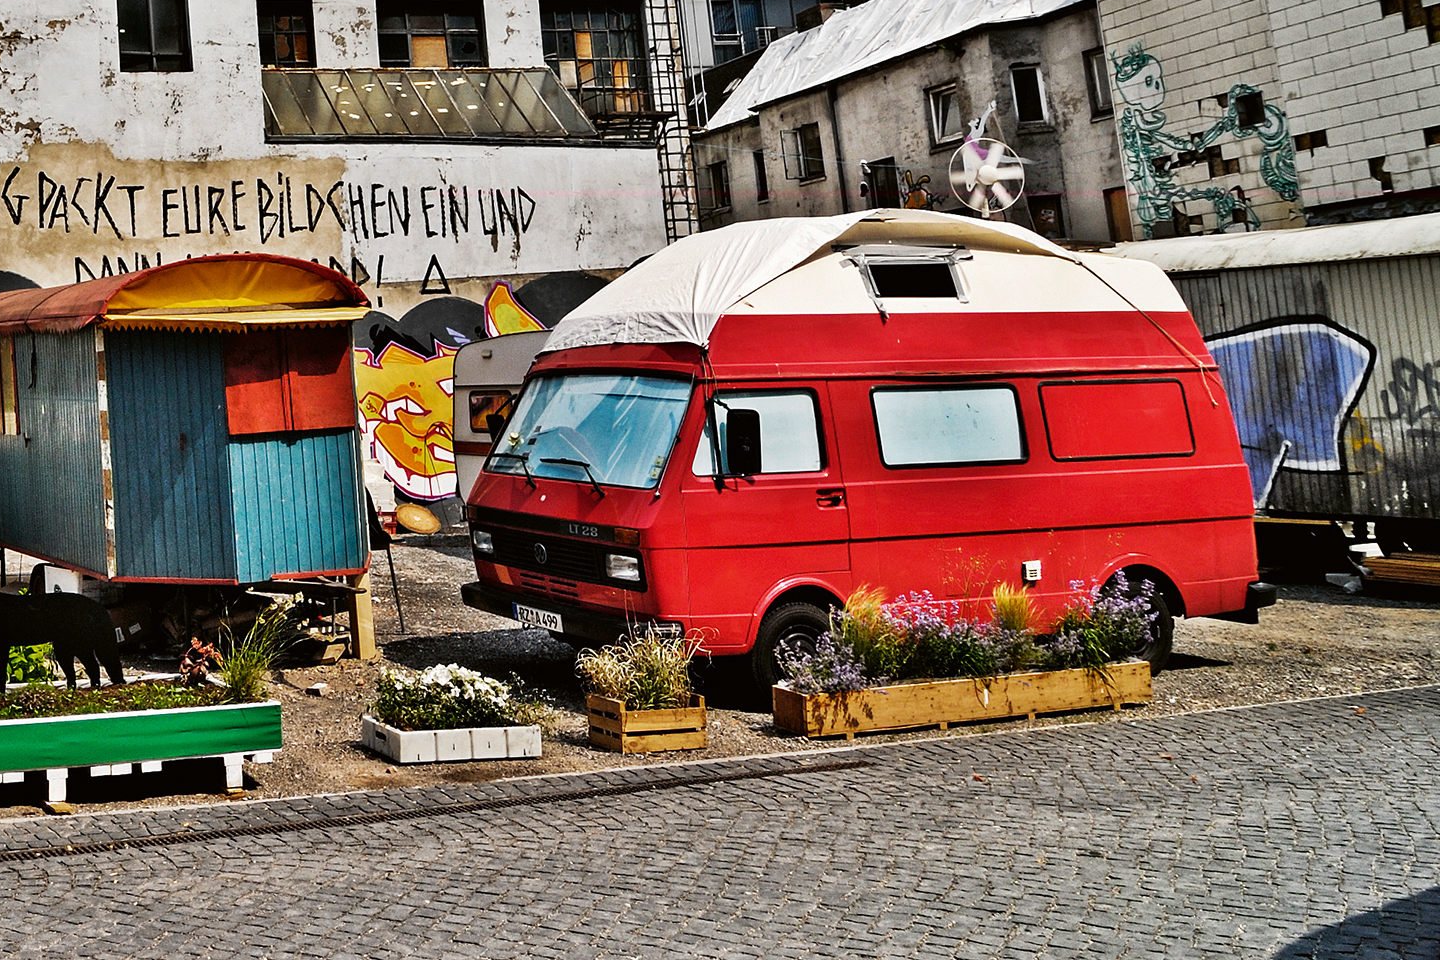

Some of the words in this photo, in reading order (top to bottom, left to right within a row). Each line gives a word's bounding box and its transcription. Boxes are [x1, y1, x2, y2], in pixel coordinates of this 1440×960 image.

[37, 171, 145, 240] PACKT
[162, 180, 247, 238] EURE
[477, 185, 537, 238] UND
[568, 523, 580, 535] LT
[581, 526, 598, 538] 28
[519, 606, 530, 622] RZ
[542, 613, 558, 629] 499
